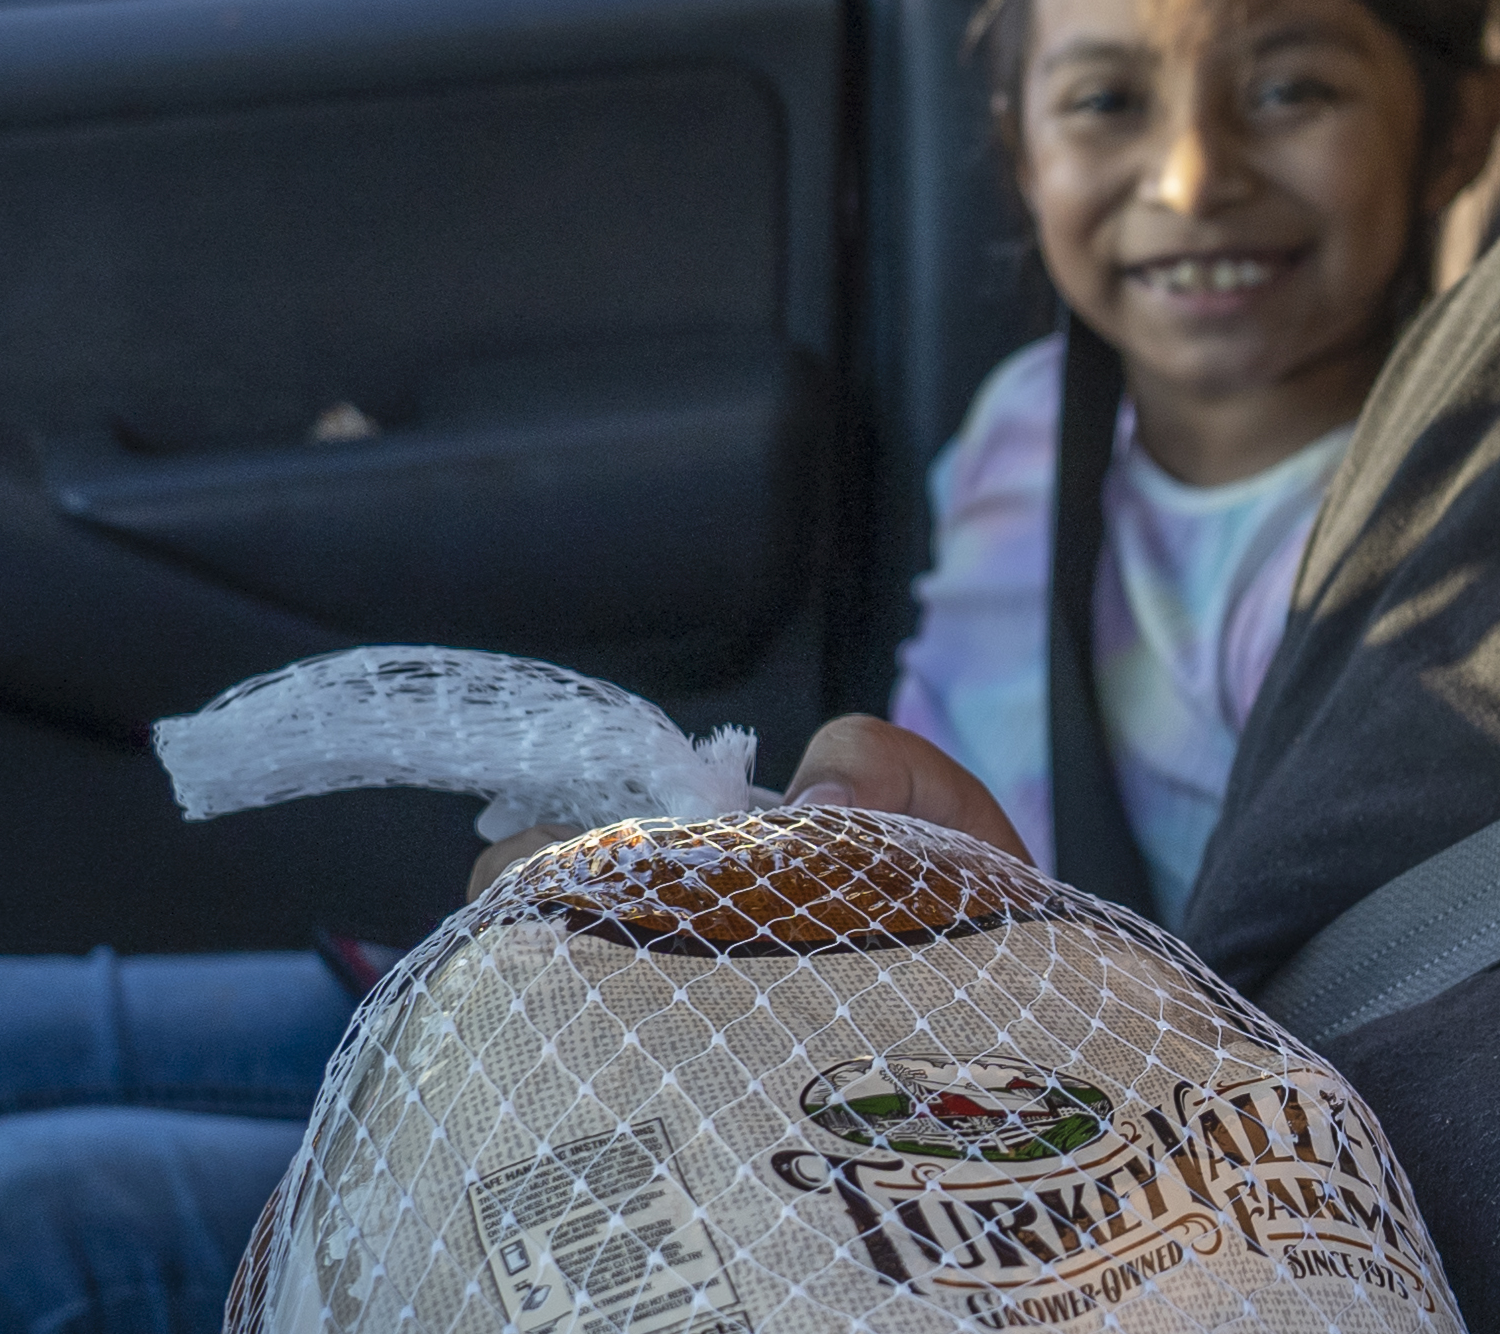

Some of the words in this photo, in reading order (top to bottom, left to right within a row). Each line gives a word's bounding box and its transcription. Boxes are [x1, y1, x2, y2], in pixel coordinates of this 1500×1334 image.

[571, 1125, 655, 1156] INSTRUCTONS
[771, 1144, 1169, 1295] TURKEY
[1284, 1244, 1359, 1280] SINCE
